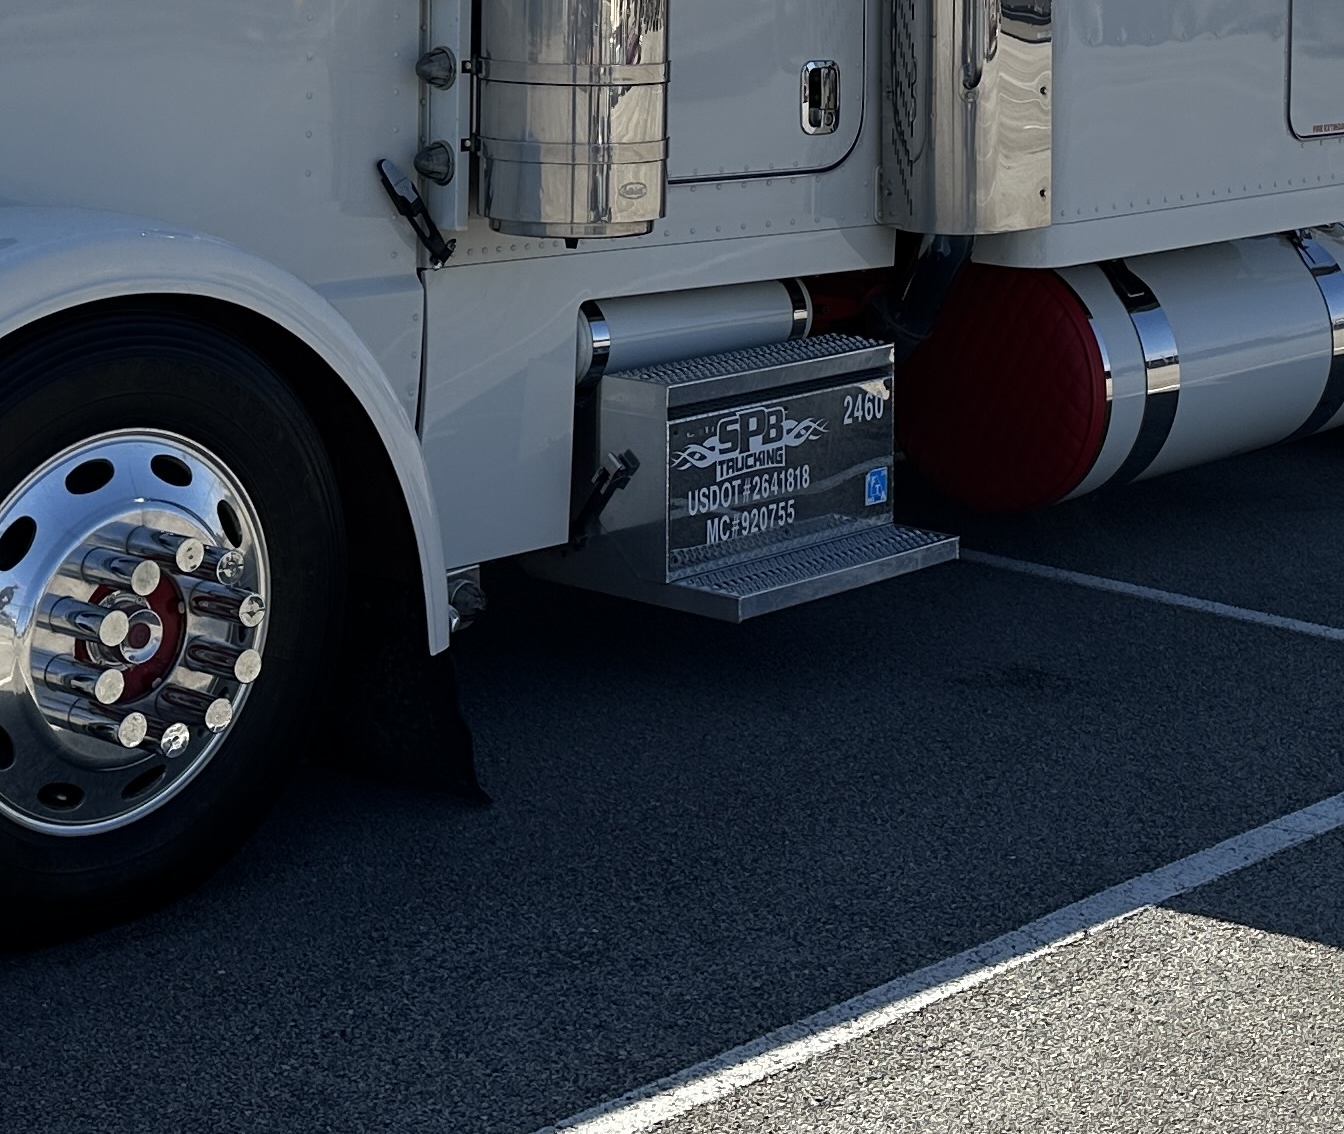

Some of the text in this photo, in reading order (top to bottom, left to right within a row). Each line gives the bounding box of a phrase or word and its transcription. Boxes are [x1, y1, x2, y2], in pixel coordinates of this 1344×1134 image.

[843, 390, 884, 425] 2460
[717, 407, 786, 456] SPB
[717, 447, 785, 480] TRUCKING
[688, 465, 810, 516] USDOT#2641818
[706, 499, 796, 544] MC#920755
